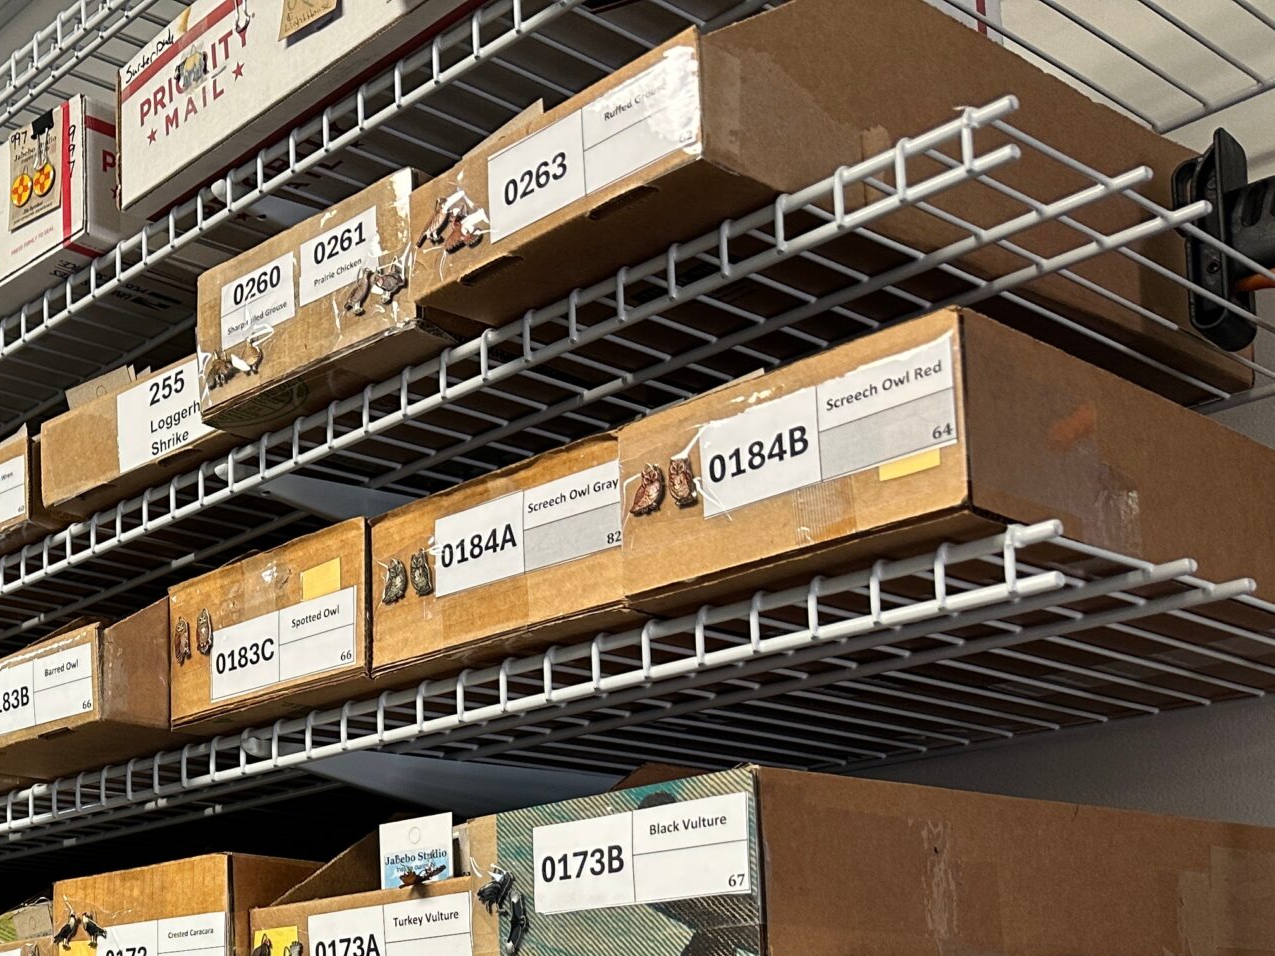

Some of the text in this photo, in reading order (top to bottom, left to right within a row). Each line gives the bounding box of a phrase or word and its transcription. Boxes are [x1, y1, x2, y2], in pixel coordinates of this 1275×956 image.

[165, 81, 226, 137] MAIL
[604, 99, 633, 121] Ruffed
[504, 151, 568, 206] 0263
[313, 221, 366, 265] 0261
[233, 264, 281, 306] 0260
[313, 257, 363, 288] Prairie Chicken
[264, 301, 288, 317] Grouse
[149, 369, 185, 407] 255
[826, 359, 943, 411] Screech Owl Red
[149, 400, 201, 434] Loggerh
[932, 422, 954, 440] 64
[151, 428, 190, 456] Shrike
[709, 424, 810, 483] 0184B
[527, 477, 619, 514] Screech Owl Gray
[441, 523, 517, 568] 0184A
[606, 530, 622, 545] 82
[291, 604, 340, 629] Spotted Owl
[44, 658, 79, 678] Barred Owl
[215, 637, 275, 675] 0183C
[340, 649, 353, 662] 66
[82, 699, 92, 710] 66
[649, 814, 727, 836] Black Vulture
[385, 853, 416, 867] Jabebo
[541, 844, 625, 883] 0173B
[728, 873, 745, 888] 67
[393, 910, 459, 928] Turkey Vulture
[167, 927, 214, 940] Crested Caracara
